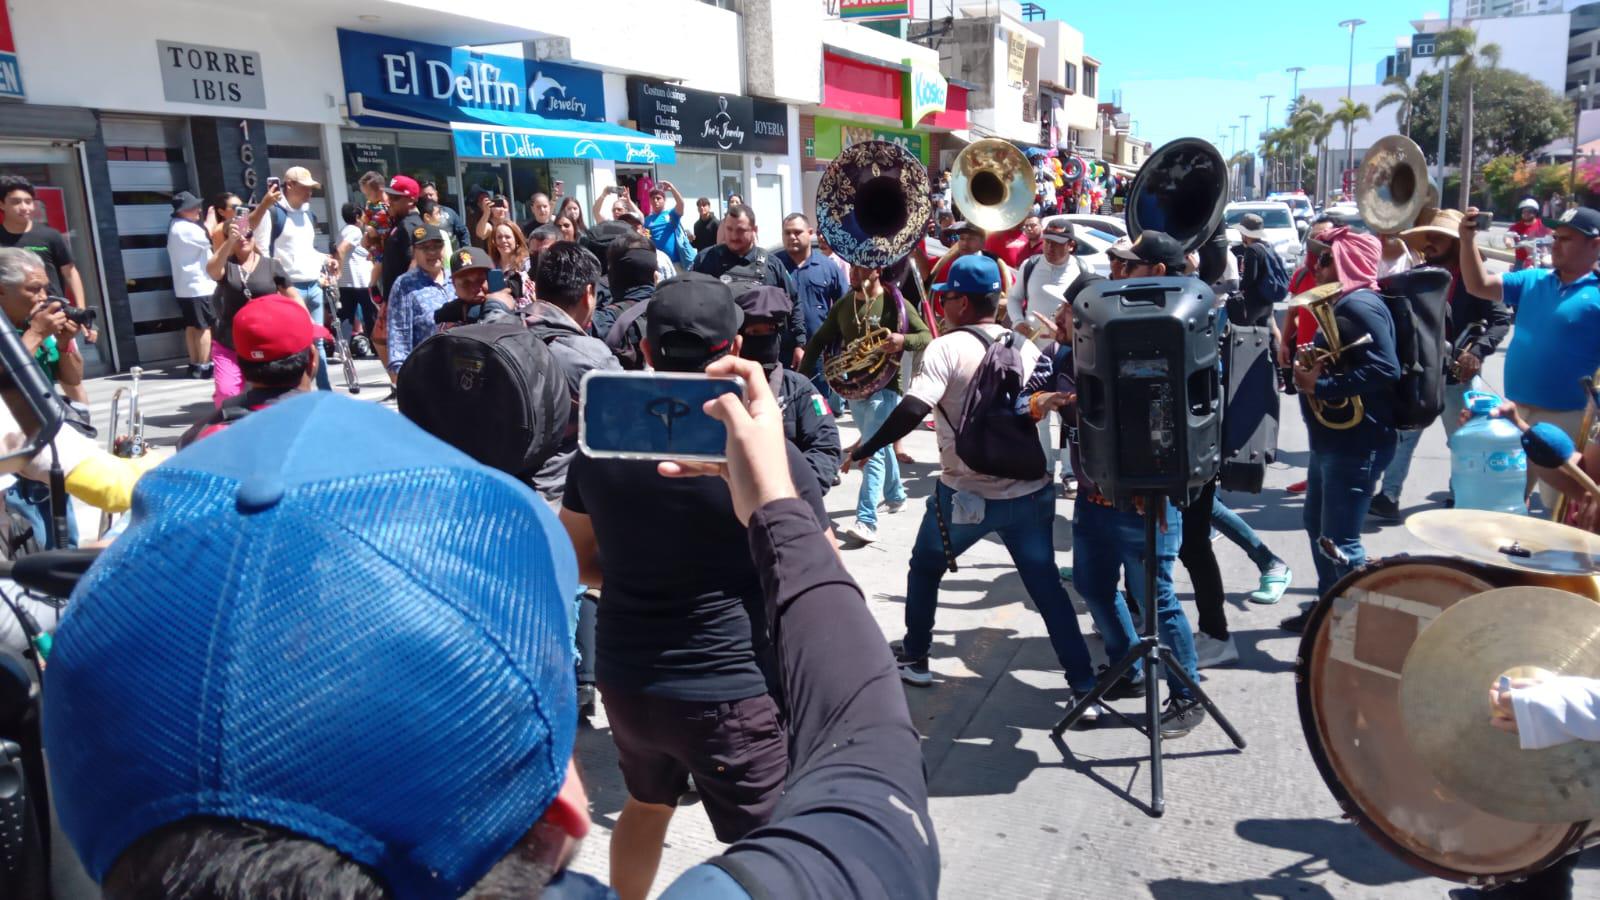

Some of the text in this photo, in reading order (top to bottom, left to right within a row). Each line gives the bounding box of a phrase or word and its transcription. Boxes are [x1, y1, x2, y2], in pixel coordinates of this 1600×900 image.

[167, 47, 255, 76] TORRE
[383, 51, 419, 96] El
[192, 79, 243, 102] IBIS
[548, 96, 587, 117] Jewelry
[656, 100, 677, 114] Repairs
[655, 115, 680, 130] Cleaning
[701, 119, 745, 145] Joe's Jewelry
[754, 120, 785, 136] JOYERIA
[481, 132, 499, 157] El
[654, 129, 683, 145] Workshop
